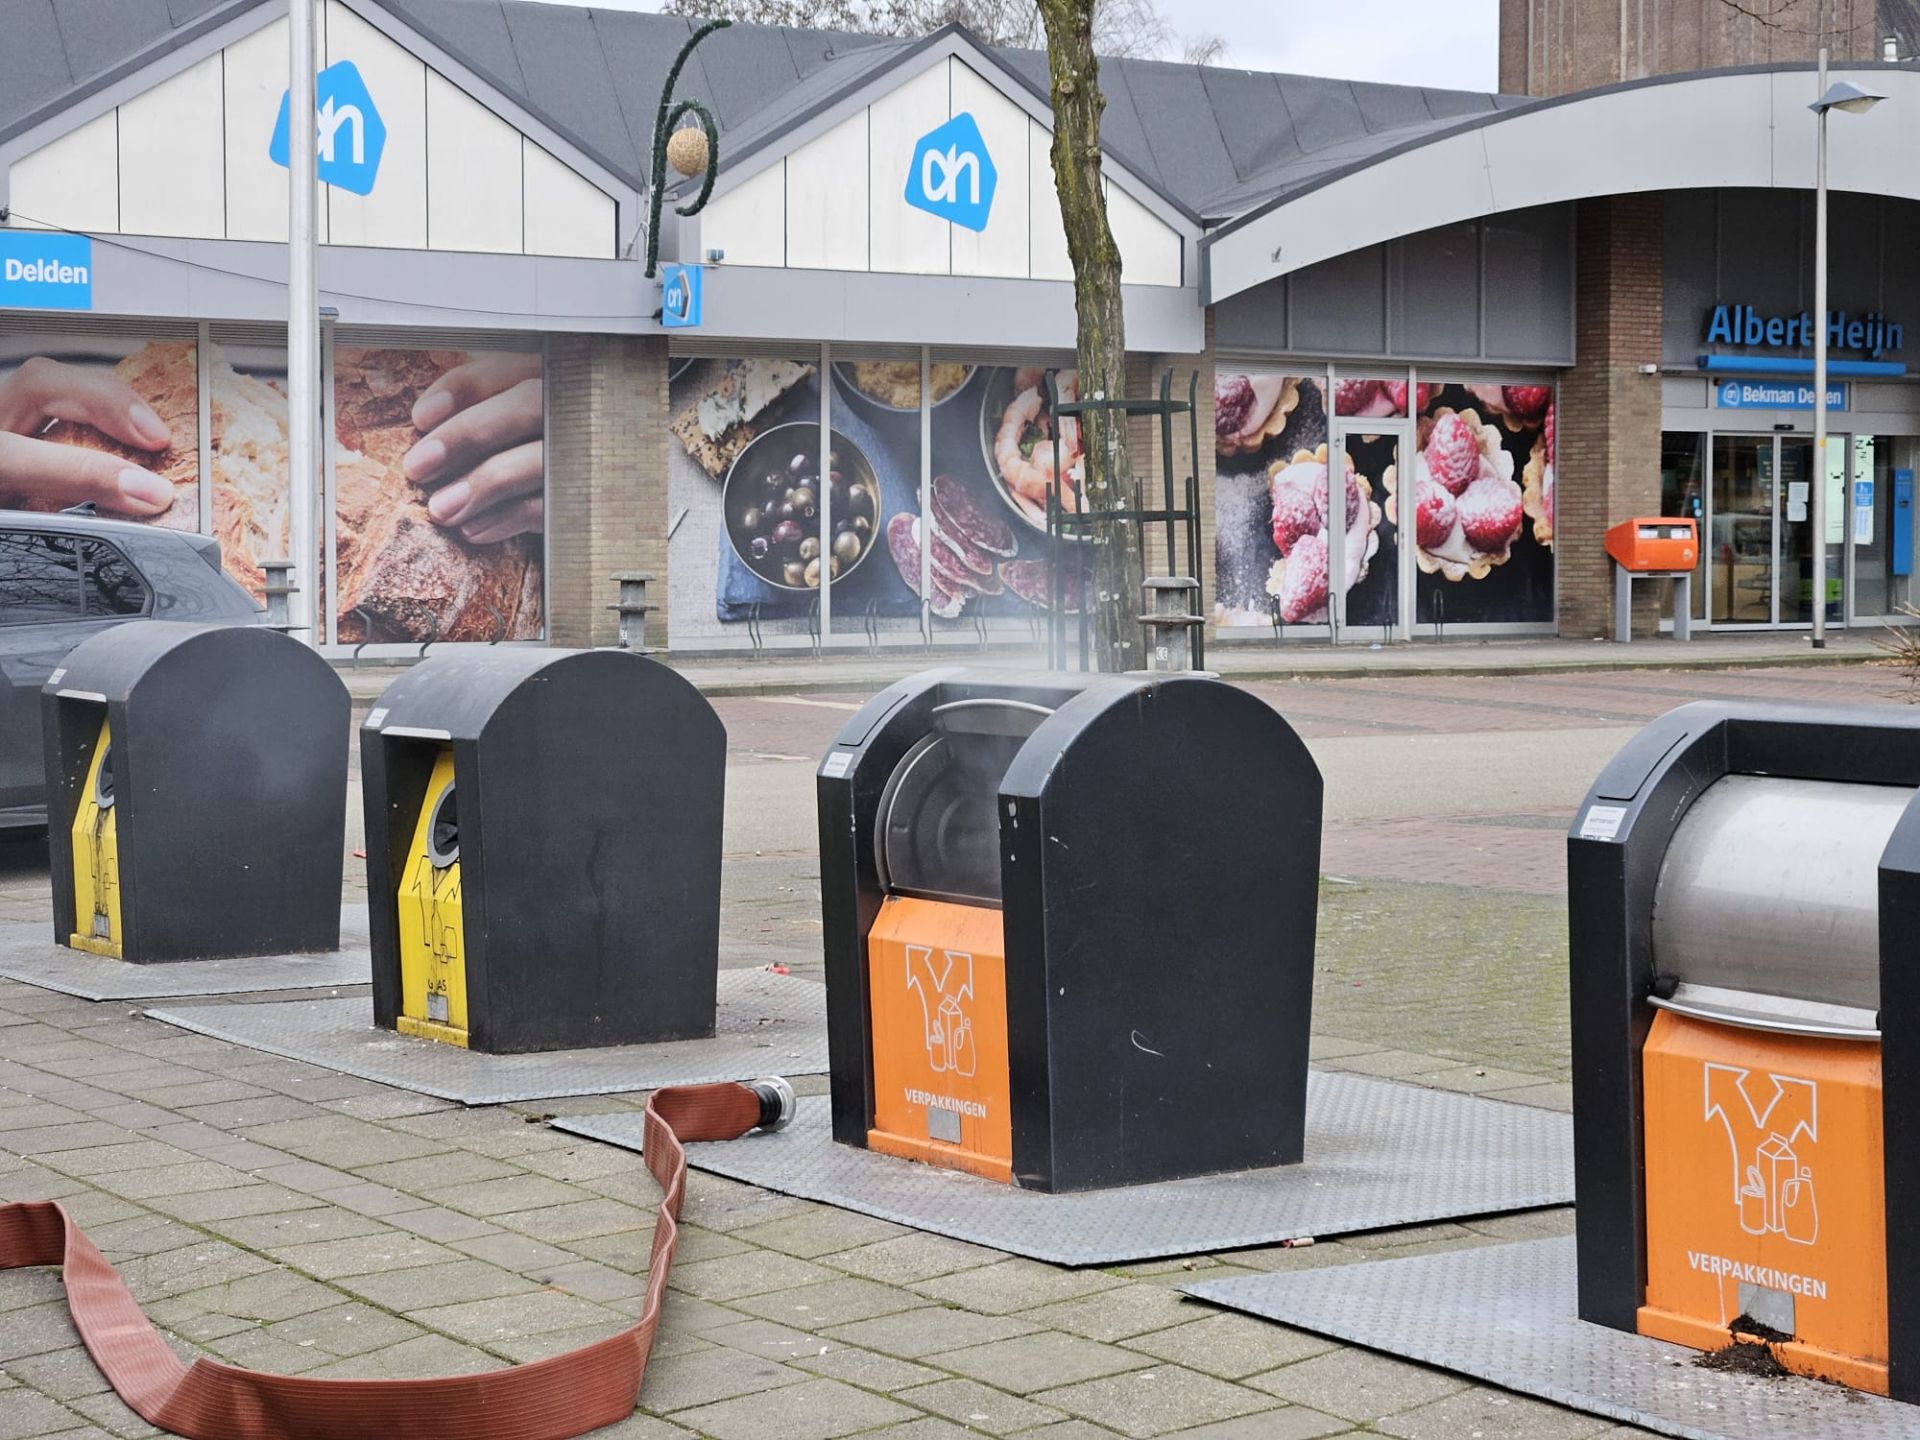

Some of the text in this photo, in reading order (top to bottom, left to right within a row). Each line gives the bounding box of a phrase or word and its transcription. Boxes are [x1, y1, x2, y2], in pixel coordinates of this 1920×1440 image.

[5, 258, 88, 284] Delden
[1707, 304, 1904, 358] Albert Heijn
[1743, 385, 1841, 404] Bekman Deen
[427, 978, 448, 991] GAS
[904, 1087, 986, 1118] VERPAKKINGEN
[1687, 1250, 1827, 1299] VERPAKKINGEN
